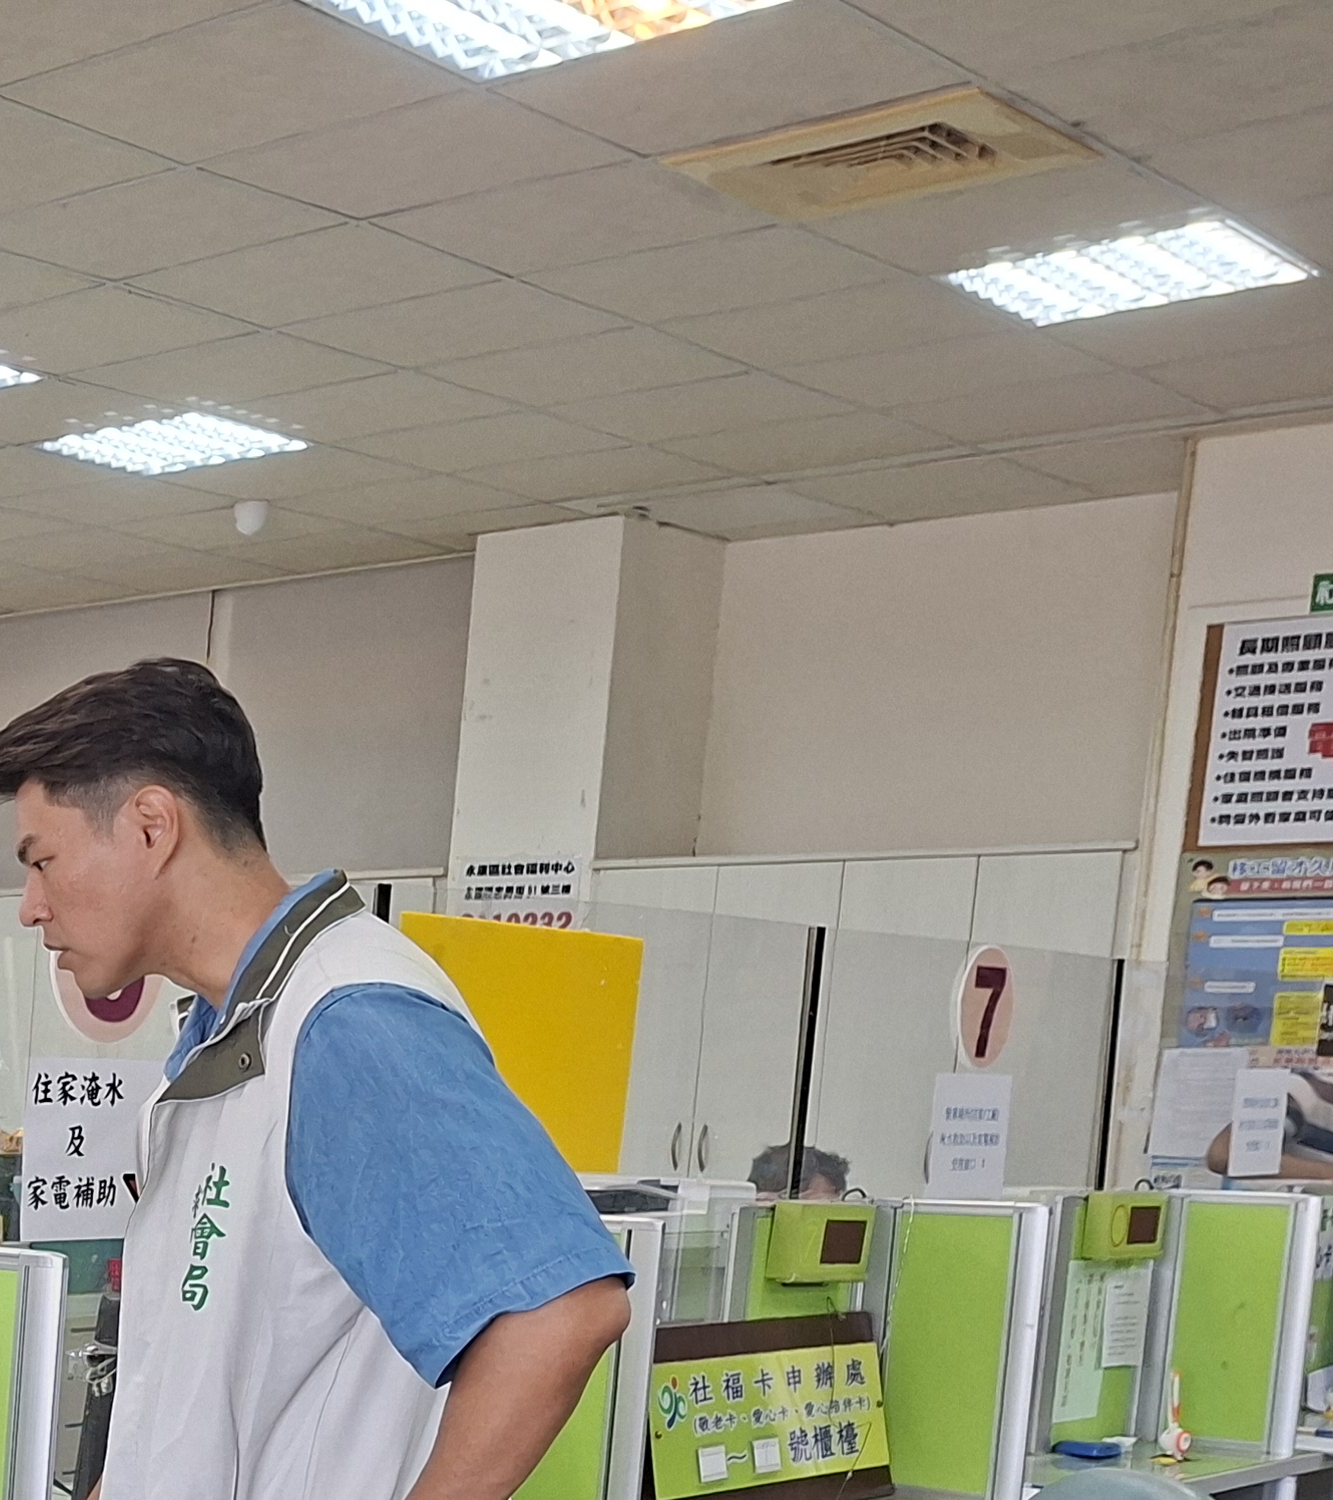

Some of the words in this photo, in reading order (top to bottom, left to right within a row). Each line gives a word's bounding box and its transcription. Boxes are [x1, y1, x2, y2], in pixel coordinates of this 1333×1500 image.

[975, 965, 1007, 1058] 7
[32, 1071, 124, 1107] 住家淹水
[65, 1125, 85, 1157] 及
[27, 1173, 117, 1210] 家電補助
[182, 1162, 230, 1311] 社會局
[689, 1358, 866, 1405] 社福卡申辦處
